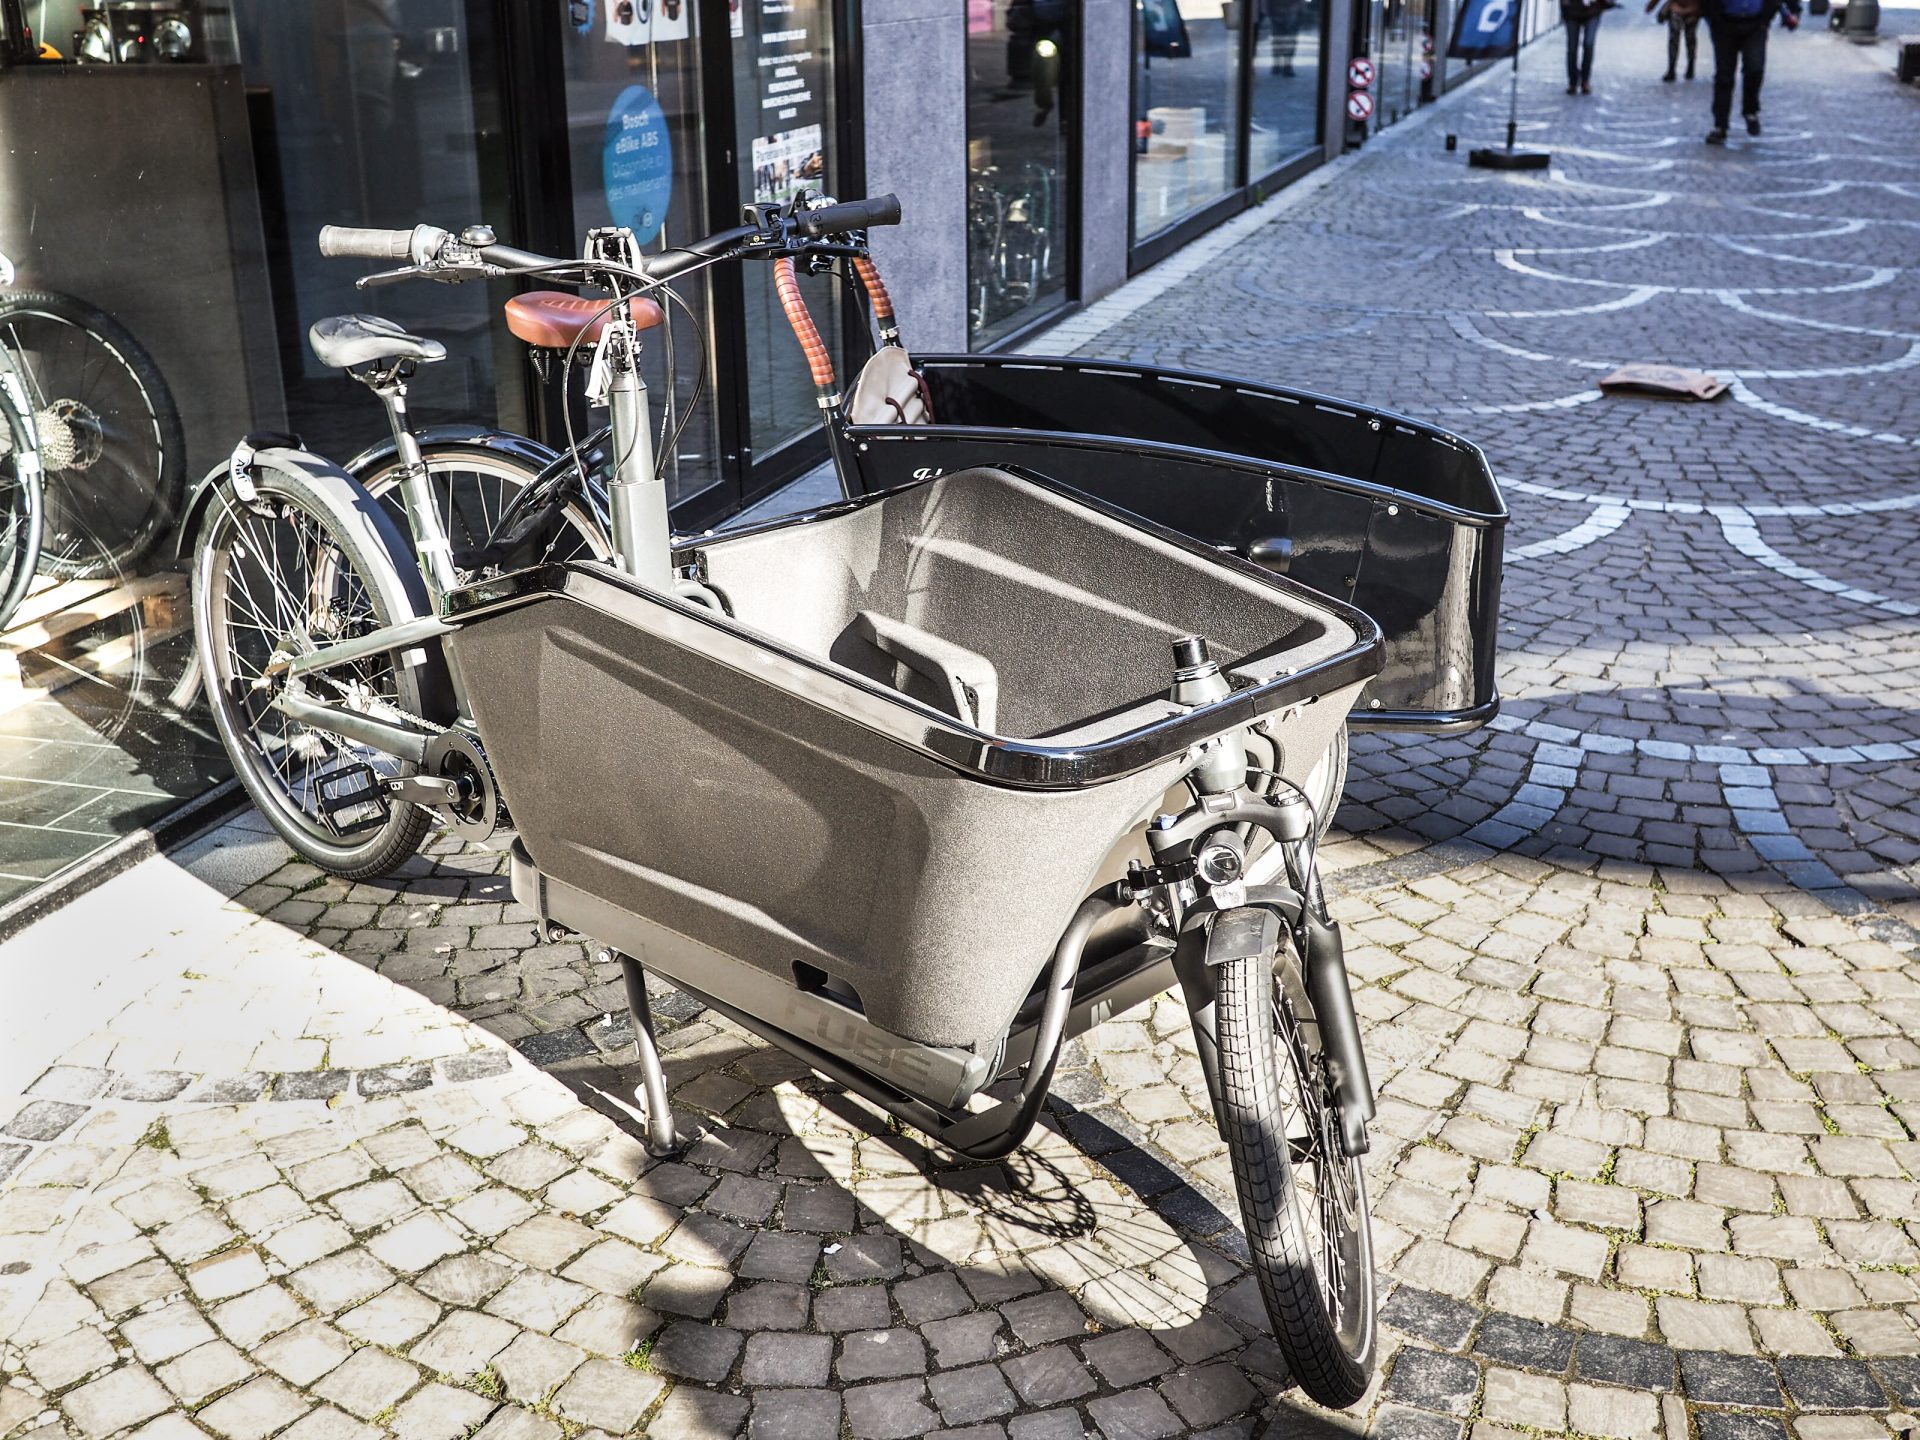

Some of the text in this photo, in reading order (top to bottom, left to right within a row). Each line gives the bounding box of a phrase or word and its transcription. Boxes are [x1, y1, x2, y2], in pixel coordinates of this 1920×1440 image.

[622, 111, 649, 130] Bosch
[615, 130, 660, 154] eBike ABS
